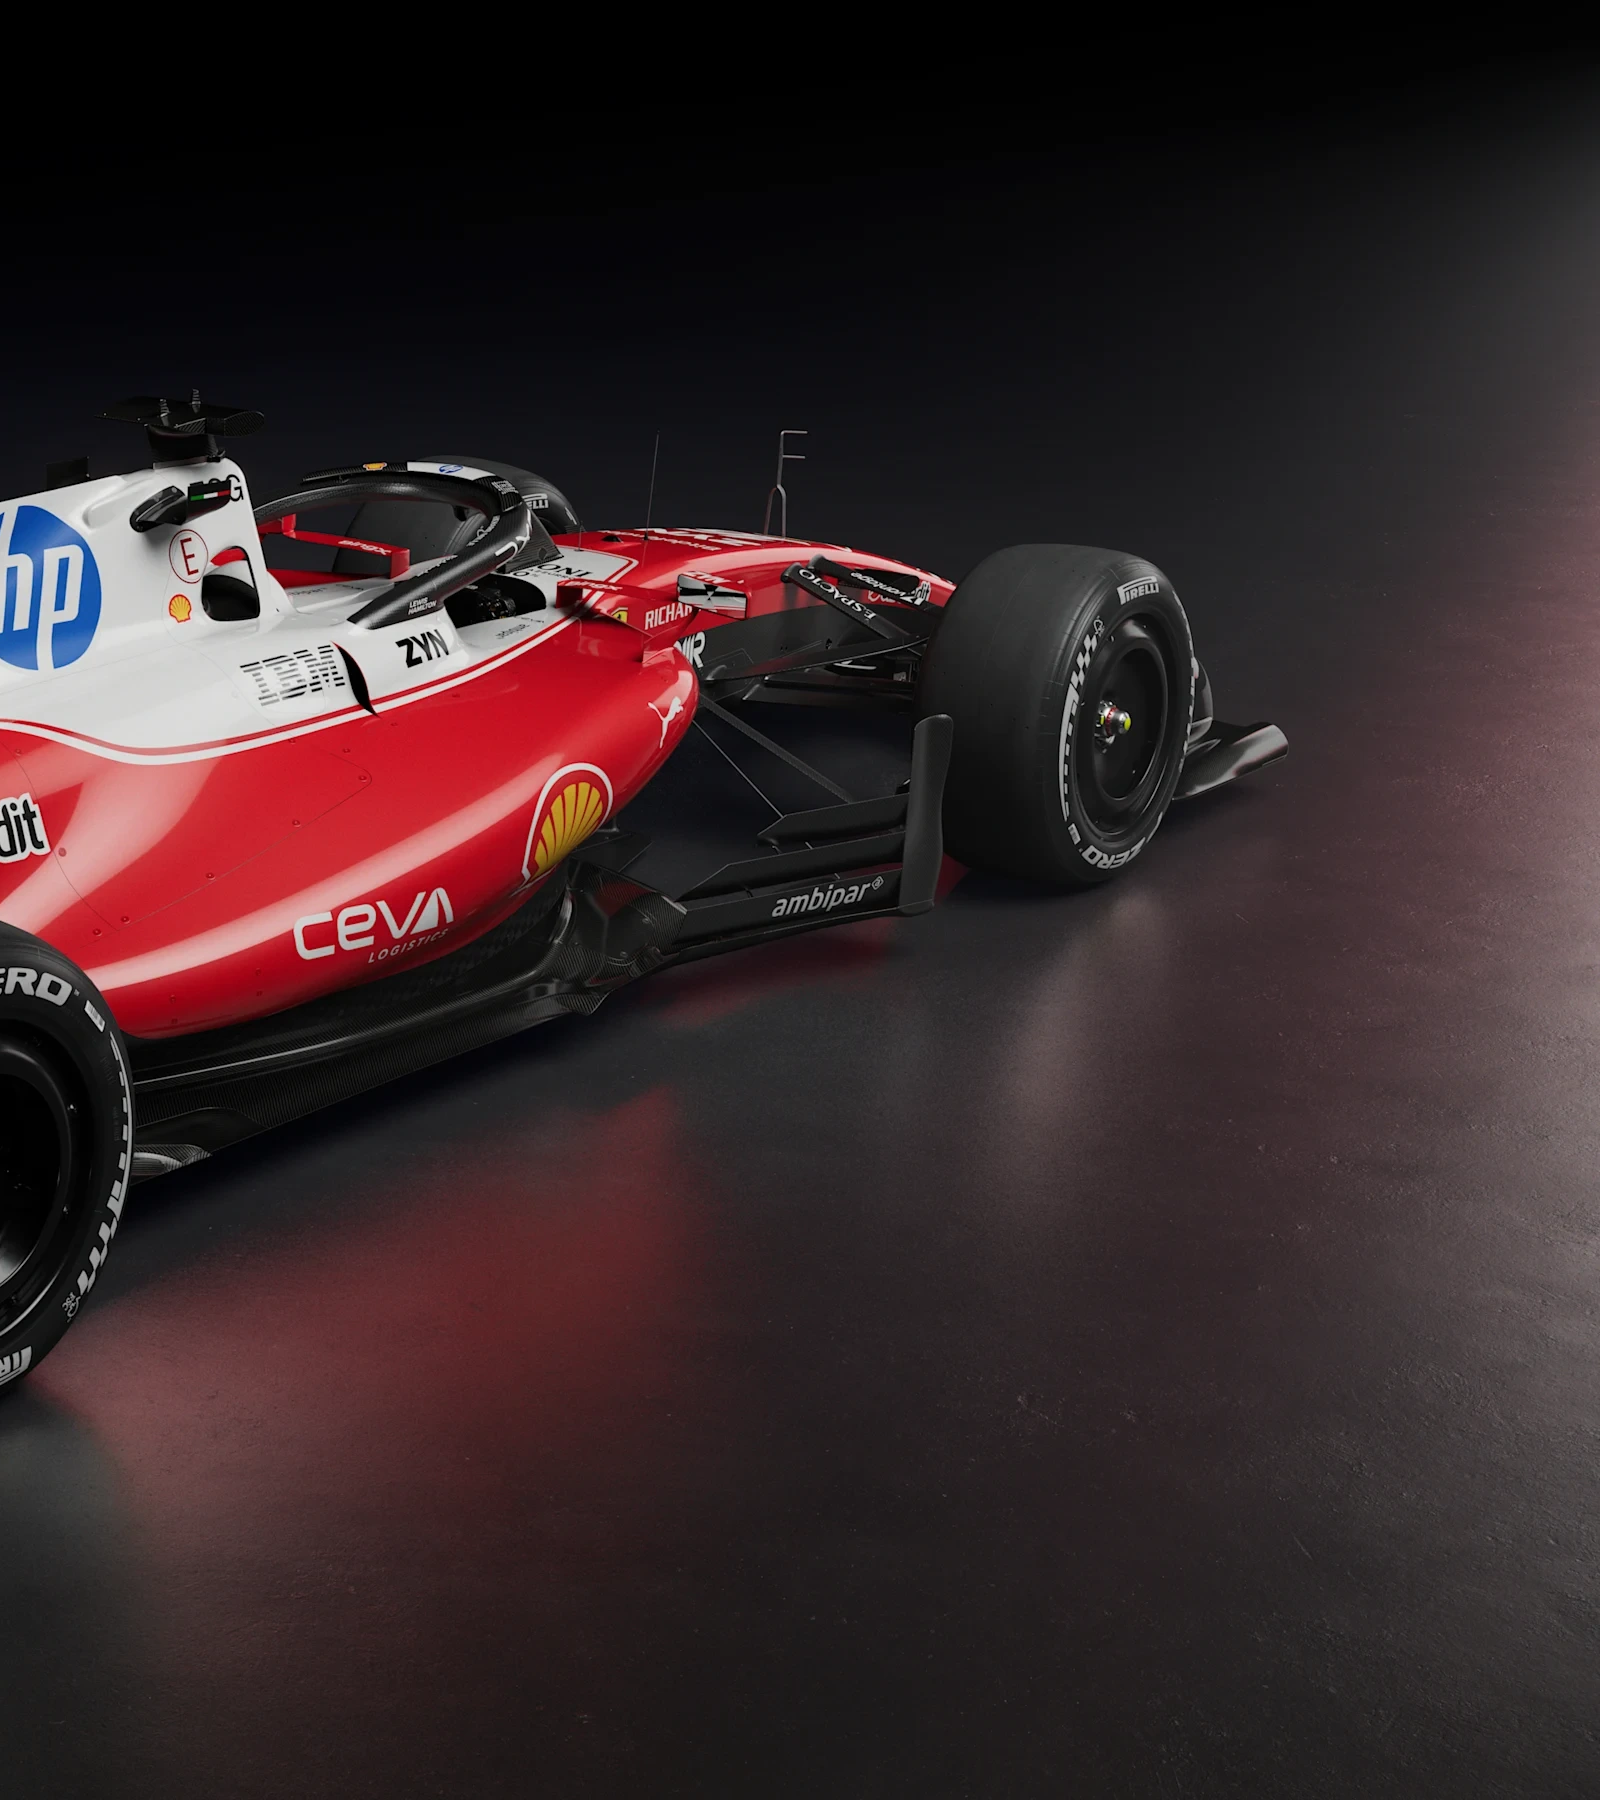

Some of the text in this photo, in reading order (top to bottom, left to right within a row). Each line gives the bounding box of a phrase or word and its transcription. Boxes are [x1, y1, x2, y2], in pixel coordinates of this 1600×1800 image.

[180, 538, 199, 576] E
[408, 600, 437, 615] HAMILTON
[409, 597, 428, 608] LEWIS
[1117, 576, 1160, 605] PIRELLI
[395, 629, 450, 668] ZYN
[240, 645, 345, 706] IBM
[771, 884, 871, 917] ambipar
[368, 928, 449, 964] LOGISTICS
